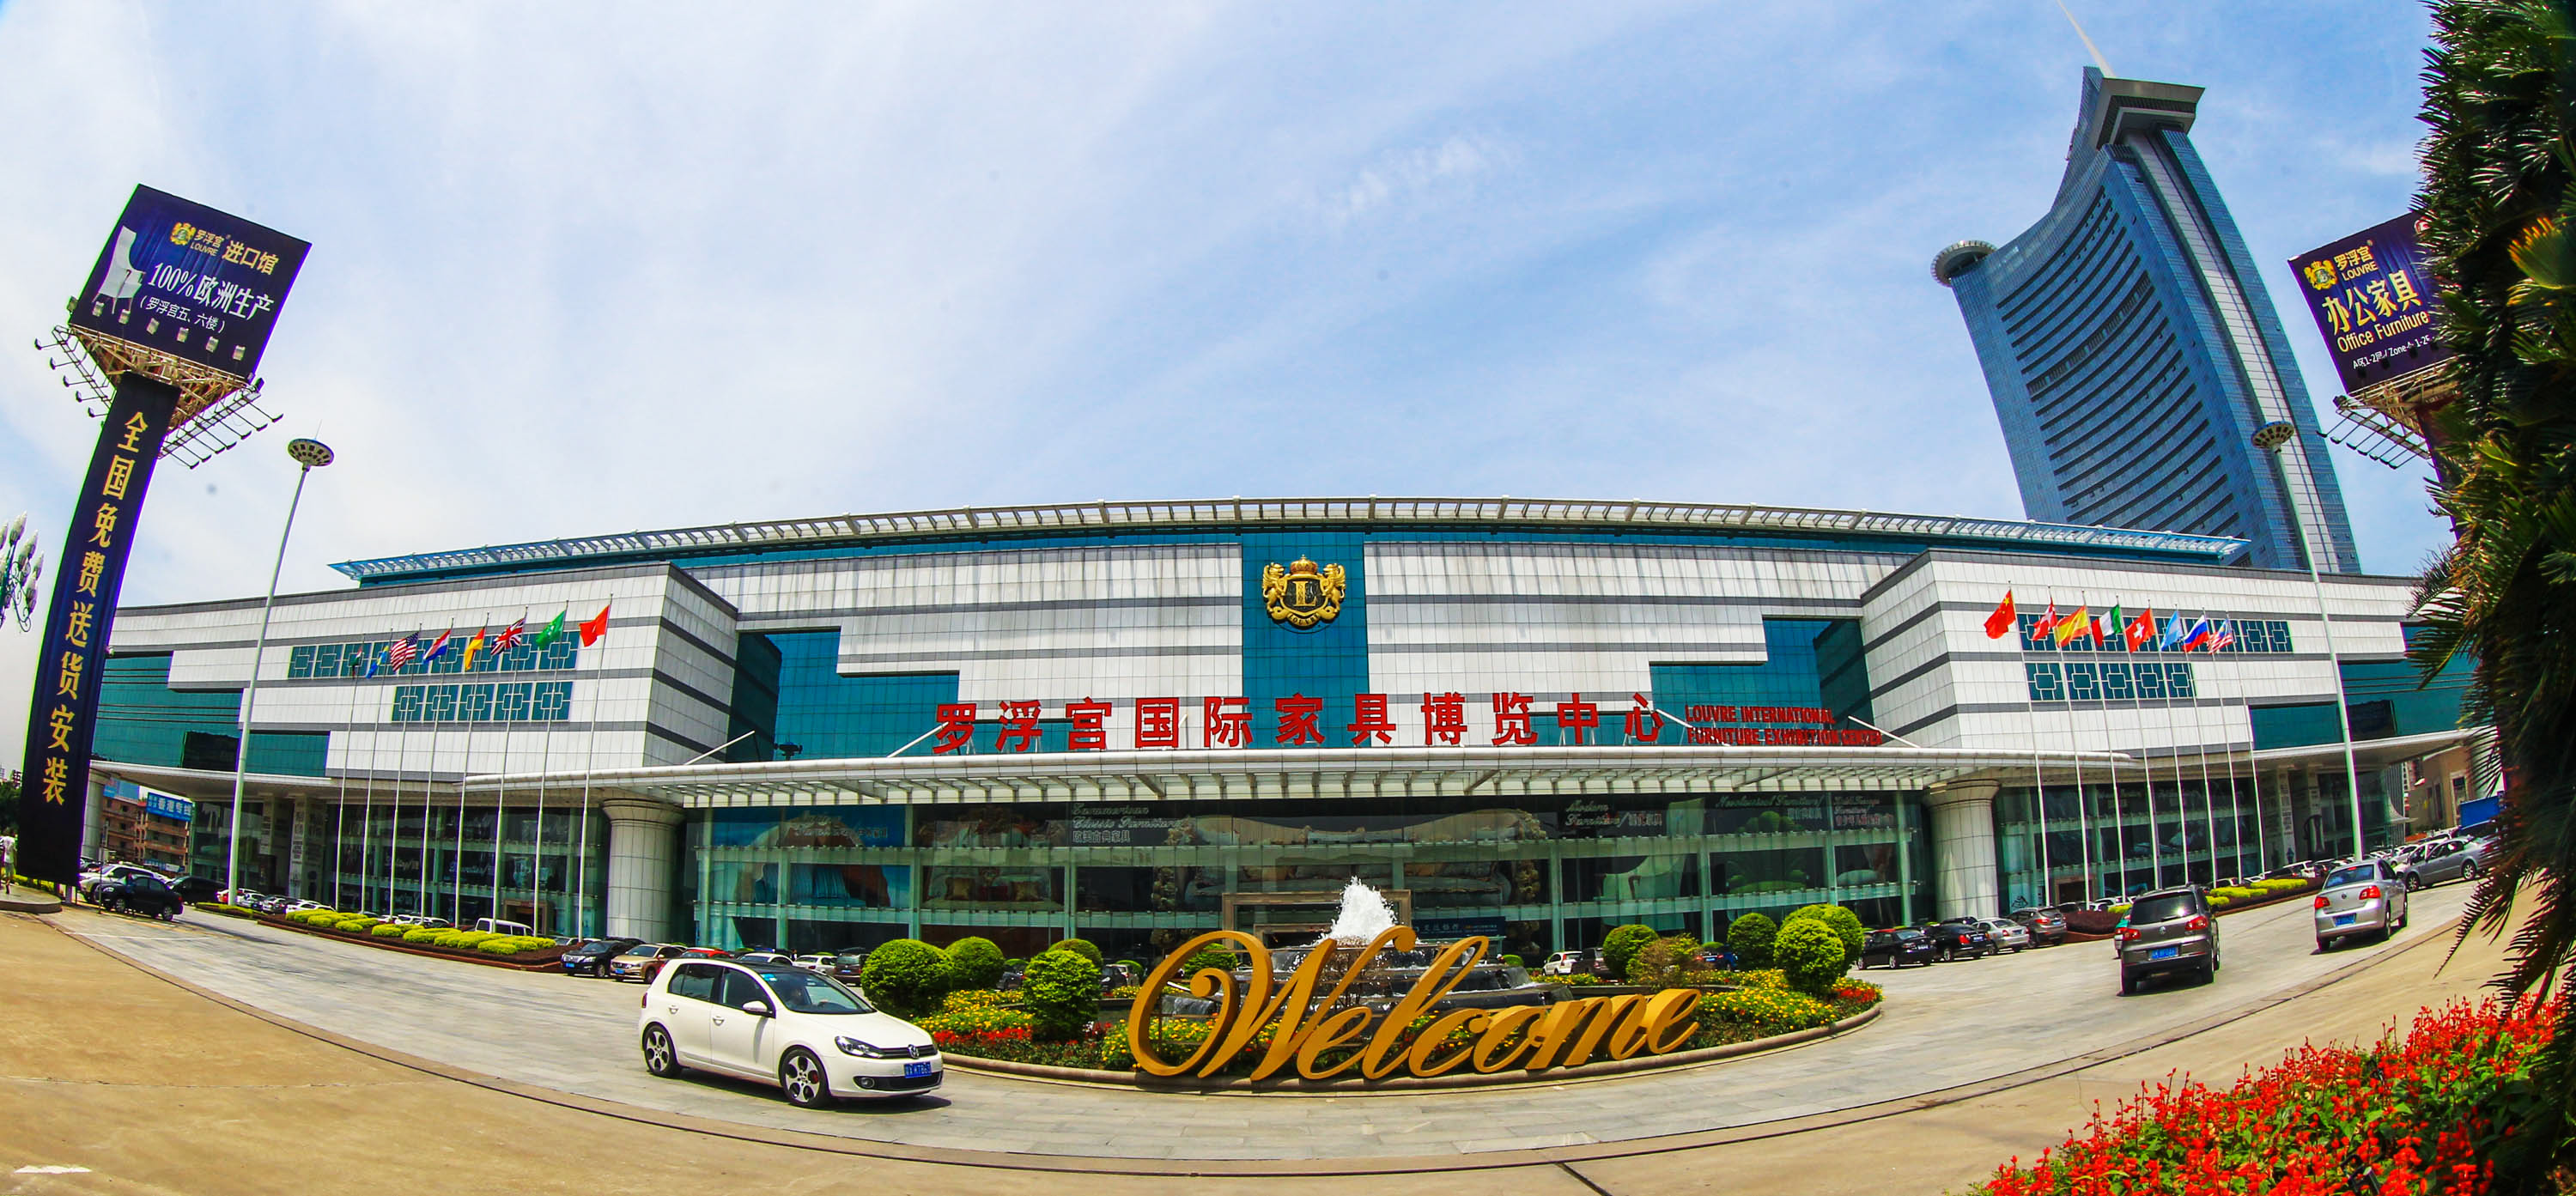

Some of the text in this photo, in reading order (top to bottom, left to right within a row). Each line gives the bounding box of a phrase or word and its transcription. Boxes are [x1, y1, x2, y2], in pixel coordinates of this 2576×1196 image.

[190, 241, 219, 257] LOUVRE
[194, 229, 224, 248] 罗浮宫
[222, 240, 279, 276] 进口馆
[2333, 246, 2374, 271] 罗浮宫
[2342, 260, 2379, 282] LOUVRE
[2321, 270, 2423, 336] 办公家具
[2337, 310, 2430, 353] Office Furniture
[42, 410, 149, 806] 全国免费送货安装
[933, 692, 1663, 754] 罗浮宫国际家具博览中心
[1685, 704, 1837, 725] LOUVRE INTERNATIONAL
[1686, 727, 1882, 746] FURNITURE EXHIBITION CENTER
[1128, 925, 1702, 1082] Welcome
